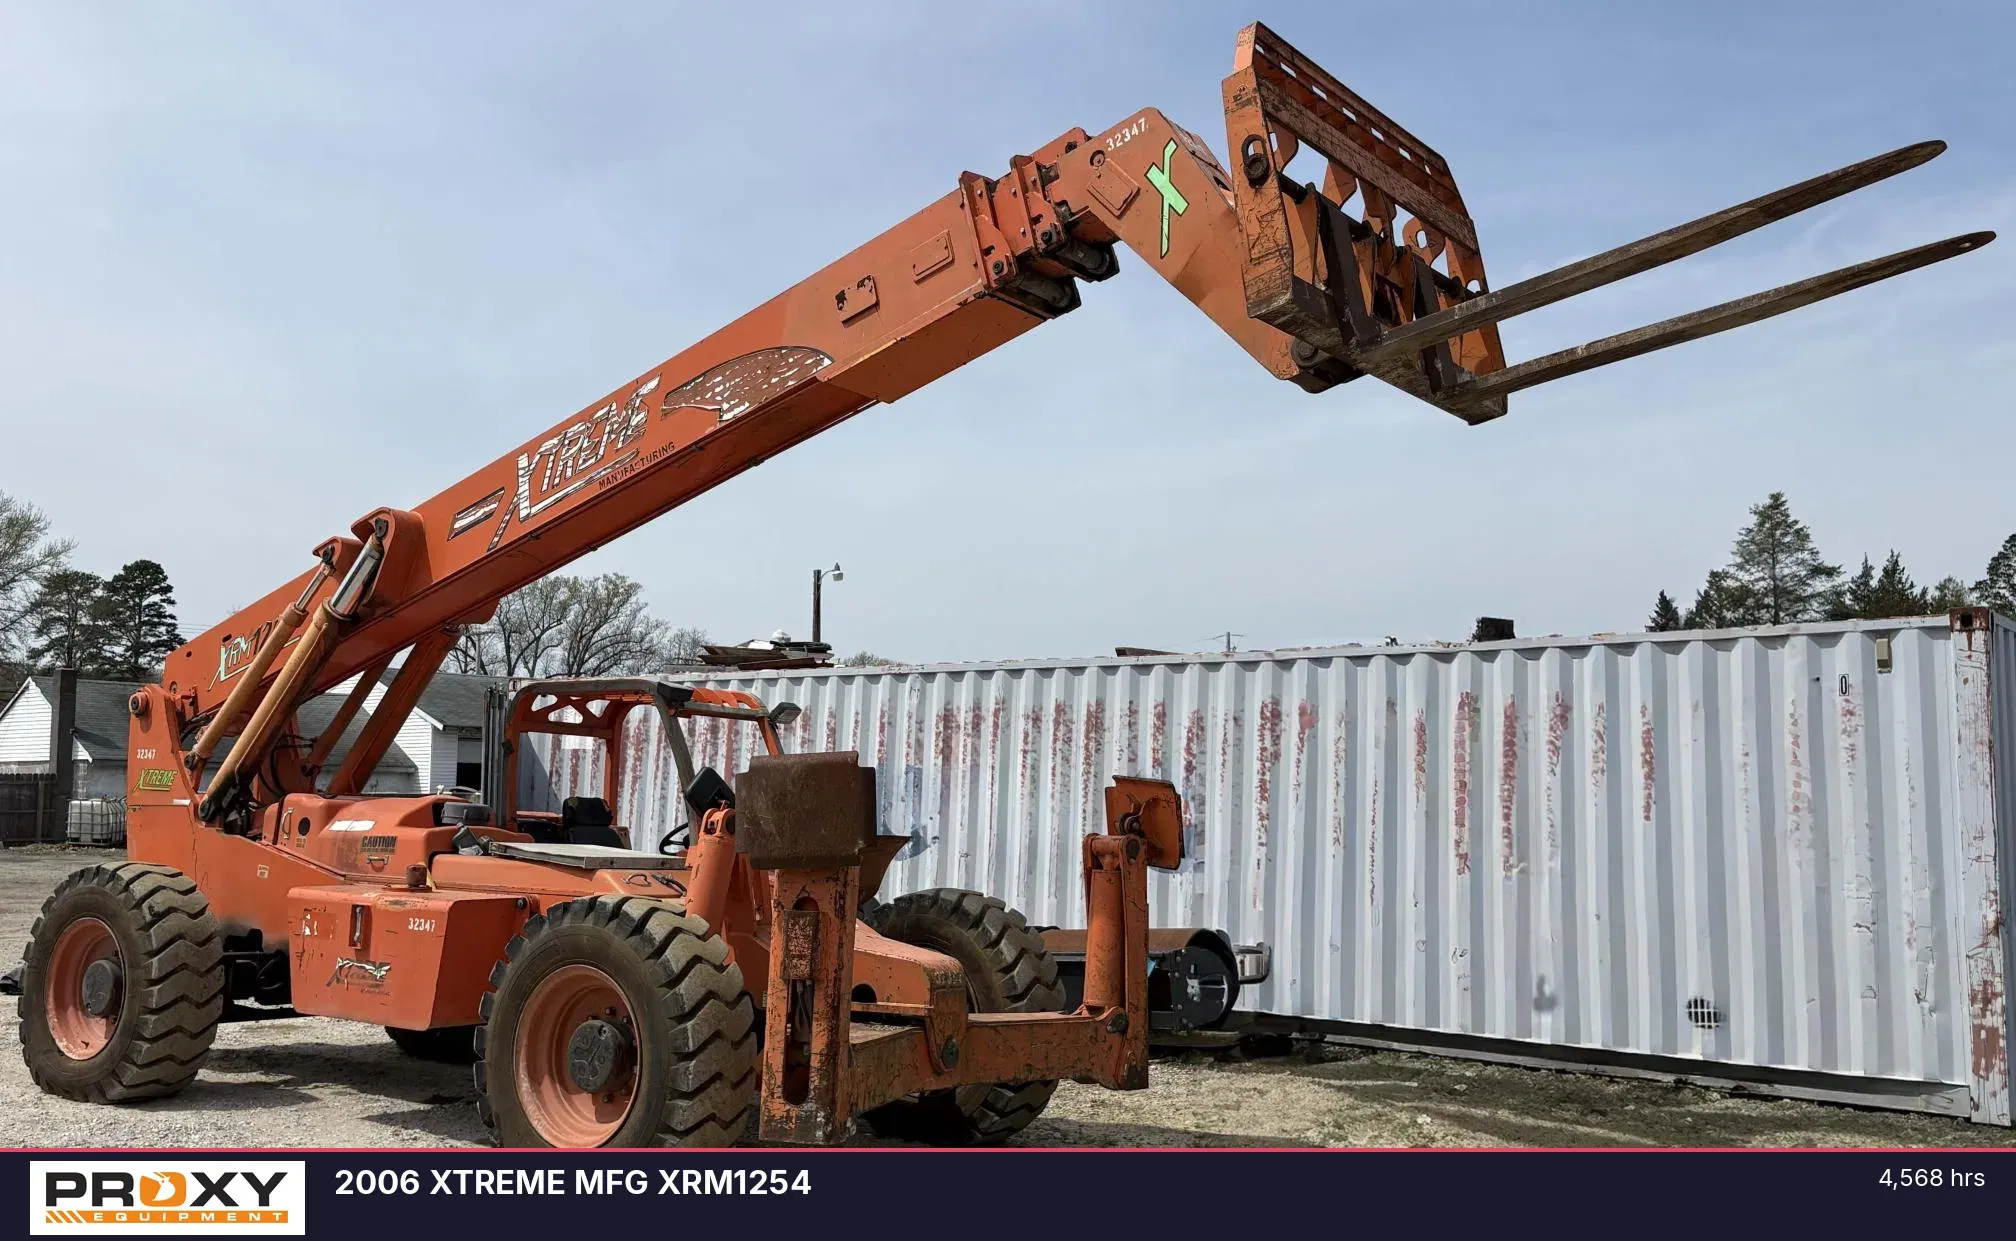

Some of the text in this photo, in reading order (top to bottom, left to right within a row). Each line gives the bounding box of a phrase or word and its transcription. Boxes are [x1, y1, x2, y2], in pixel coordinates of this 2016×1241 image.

[1106, 116, 1146, 152] 32347
[487, 373, 662, 553] XTREME
[598, 441, 676, 491] MANUFACTURING
[136, 748, 156, 760] 32347
[132, 769, 179, 793] XTREME
[362, 835, 397, 848] CAUTION
[408, 917, 436, 932] 32347
